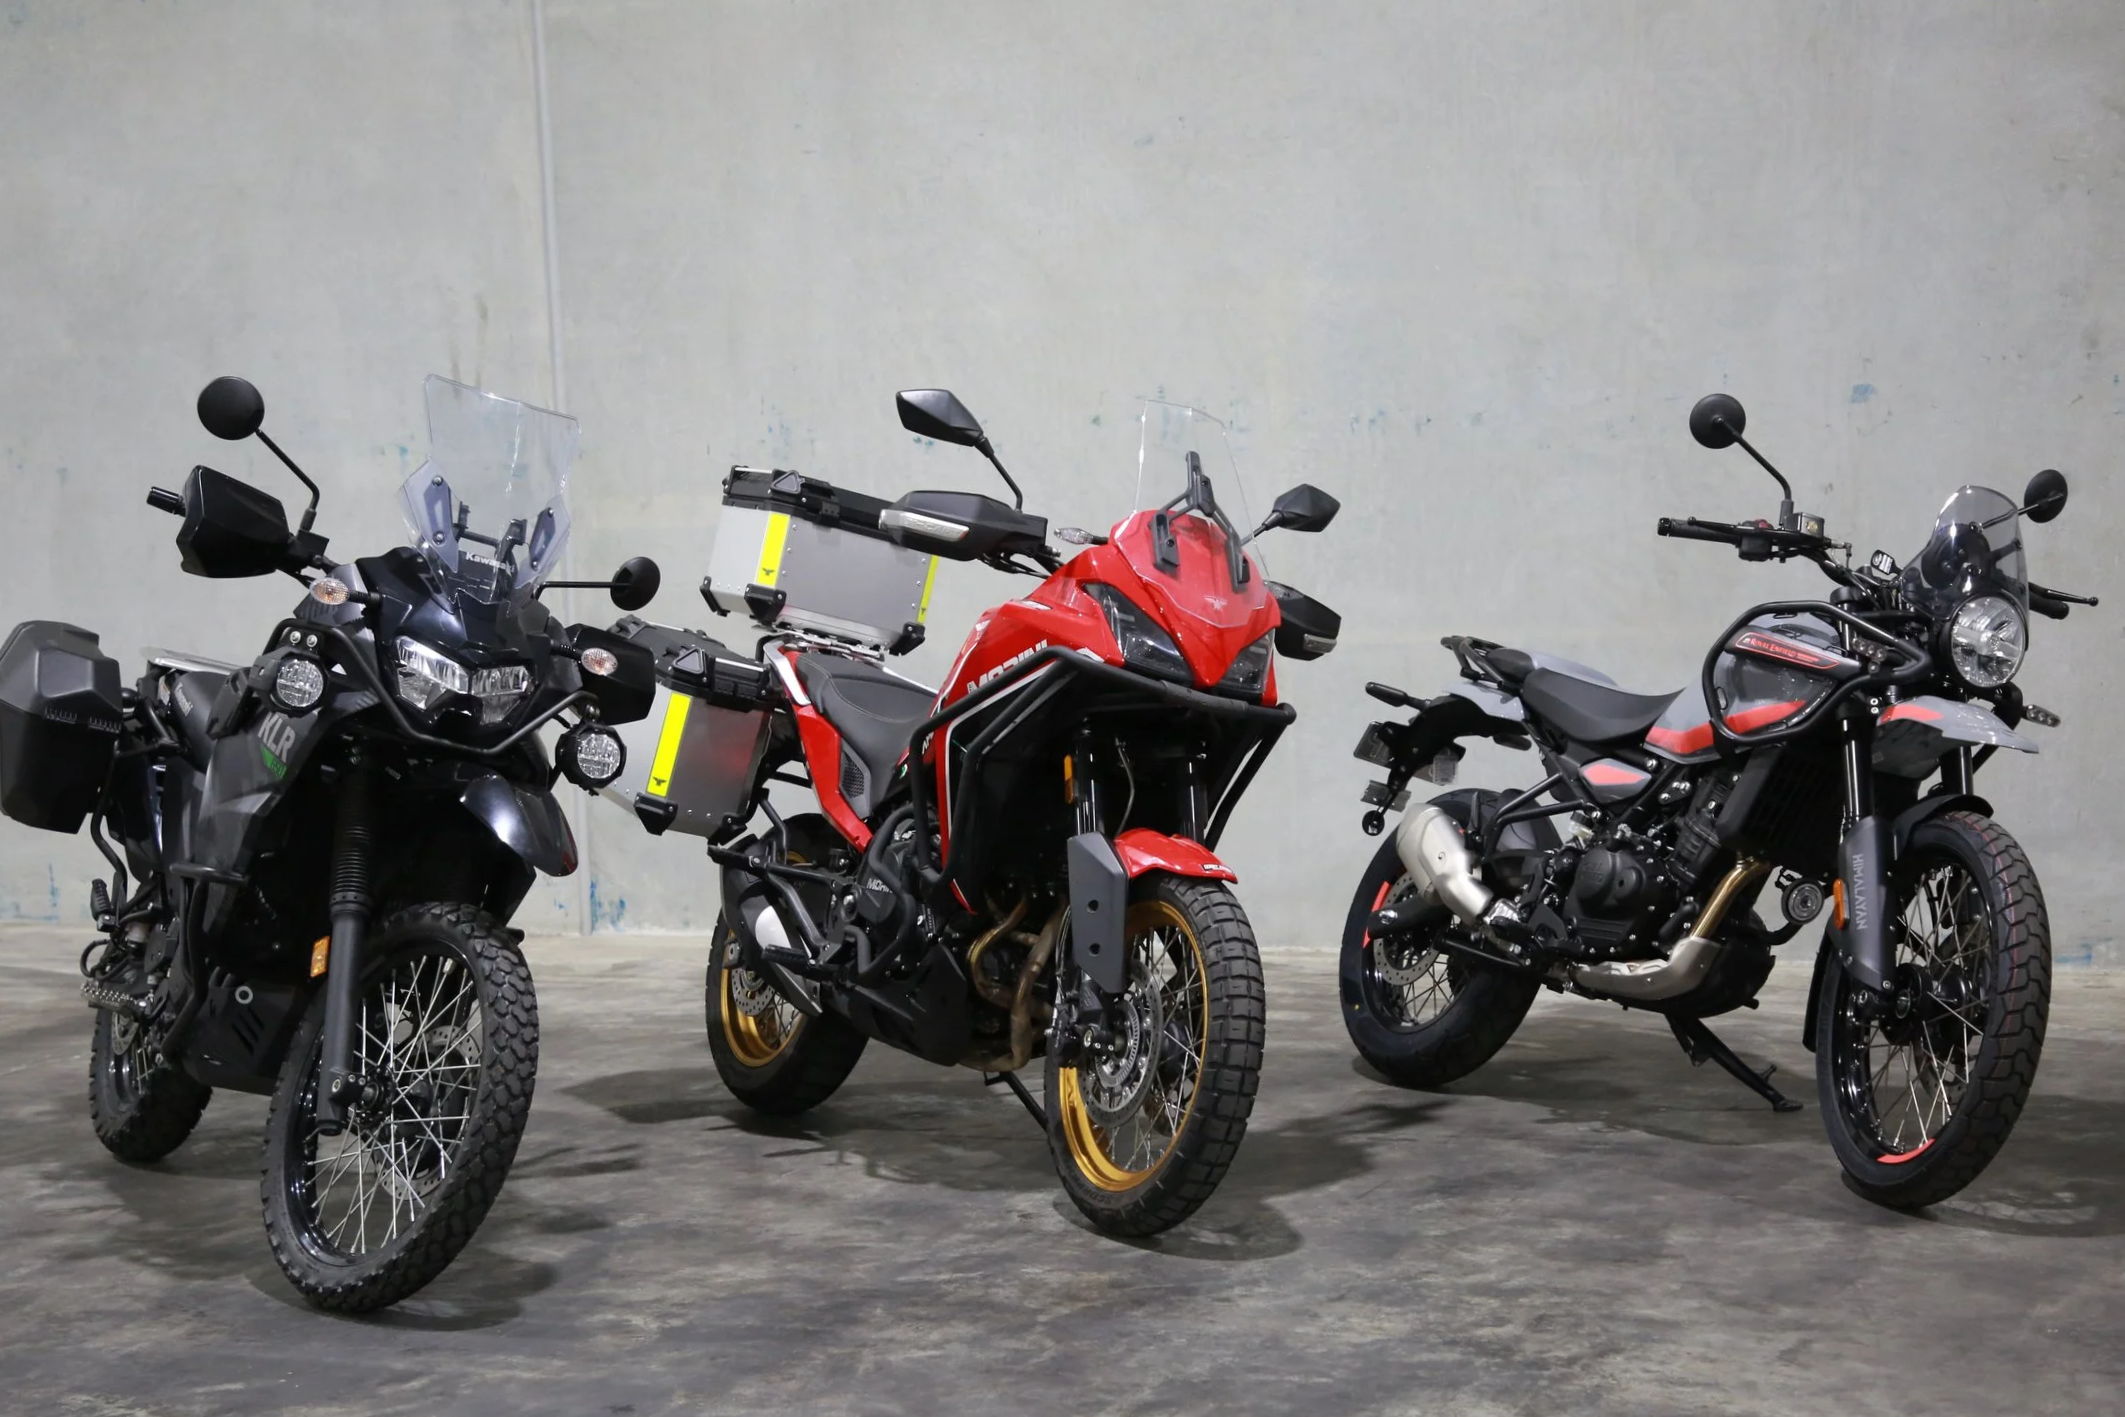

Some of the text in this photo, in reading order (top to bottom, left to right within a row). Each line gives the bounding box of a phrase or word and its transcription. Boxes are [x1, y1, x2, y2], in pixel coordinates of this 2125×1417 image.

[465, 551, 515, 574] Kawasaki
[1750, 638, 1797, 658] ROYAL ENFIELD
[257, 711, 296, 764] KLR
[1852, 853, 1868, 930] HIMALAYAN
